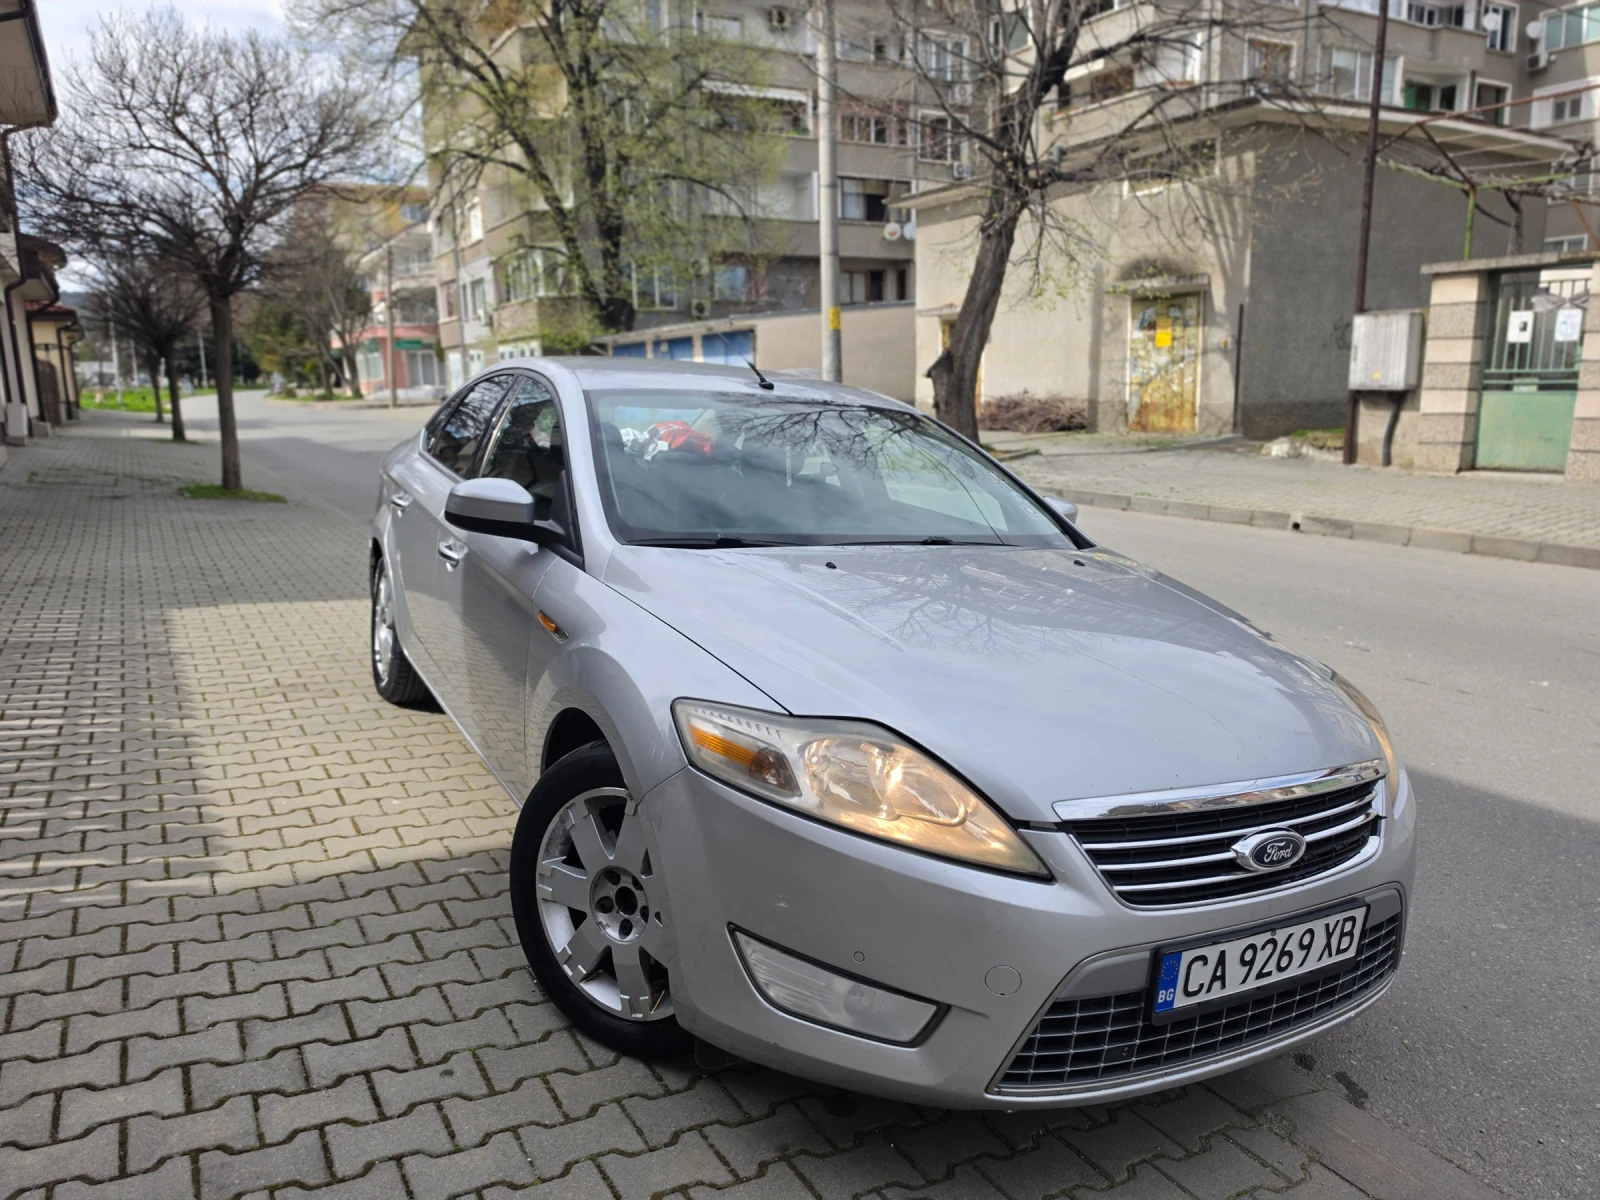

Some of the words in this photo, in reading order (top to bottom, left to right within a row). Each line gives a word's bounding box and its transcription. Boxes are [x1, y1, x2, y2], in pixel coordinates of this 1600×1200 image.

[1263, 841, 1293, 862] Ford
[1182, 949, 1227, 998] CA
[1239, 927, 1315, 985] 9269
[1316, 915, 1357, 962] XB
[1157, 988, 1175, 1004] BG
